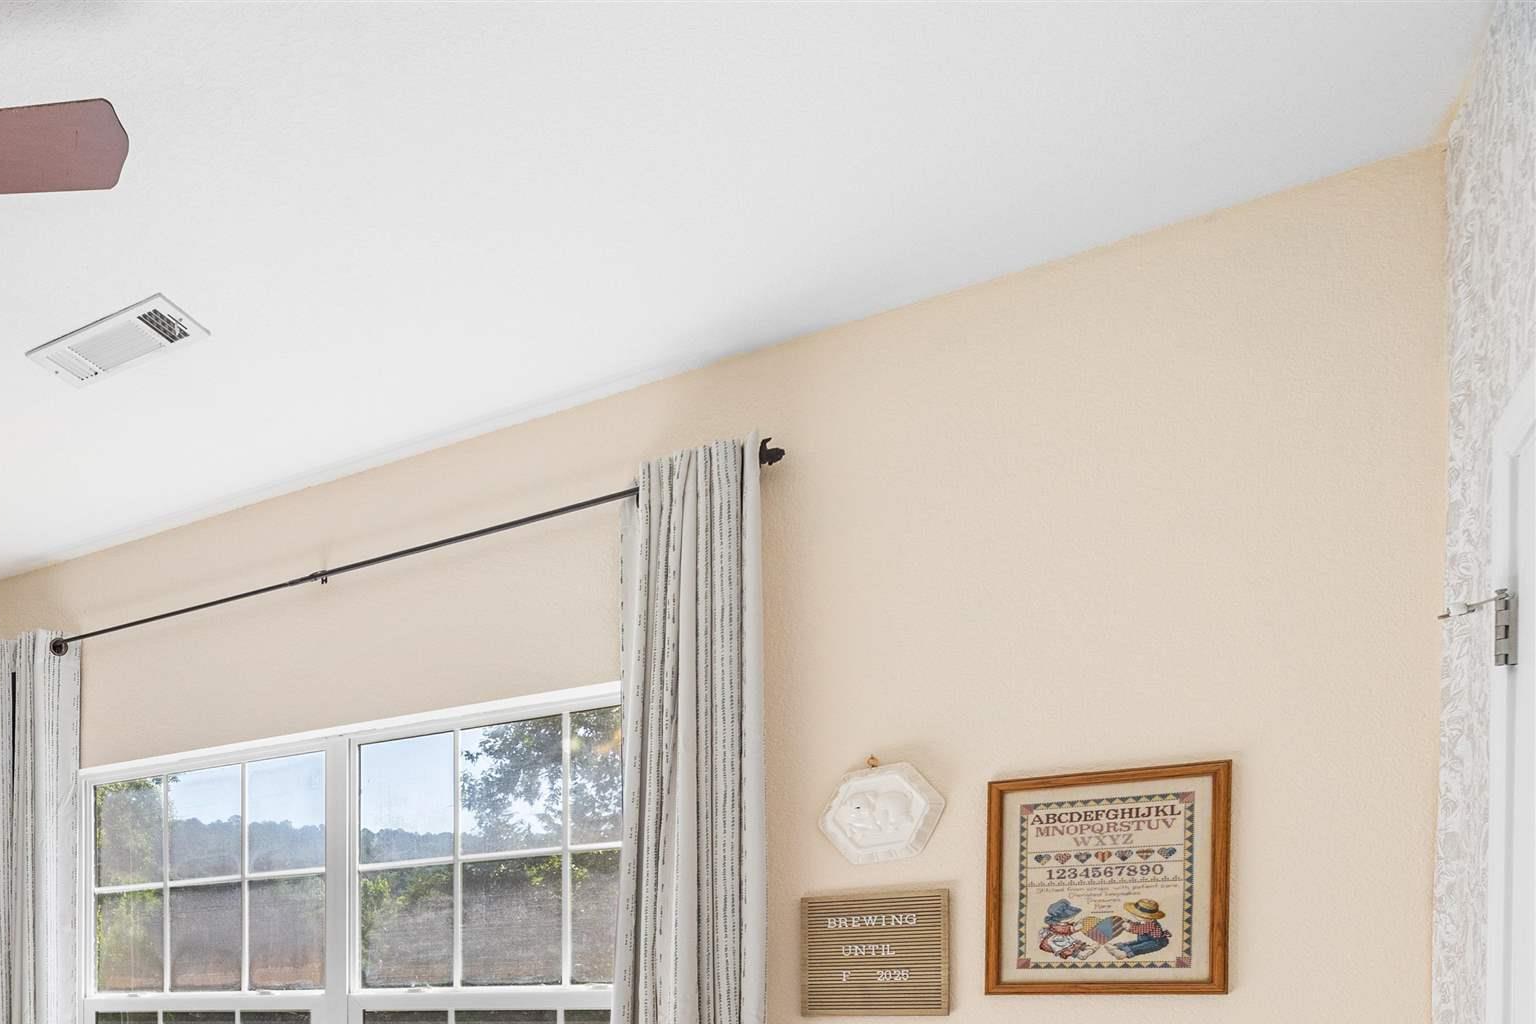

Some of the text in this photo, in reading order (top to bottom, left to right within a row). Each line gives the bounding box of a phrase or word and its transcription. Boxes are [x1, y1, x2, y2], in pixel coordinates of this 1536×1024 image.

[1030, 804, 1182, 826] ABCDEFGHIJKL
[1035, 817, 1176, 838] MNOPQRSTUV
[1072, 833, 1135, 847] WXYZ
[1046, 863, 1165, 881] 1234567890
[826, 912, 917, 929] BREWING
[841, 943, 896, 957] UNTIL
[876, 969, 910, 982] 2025
